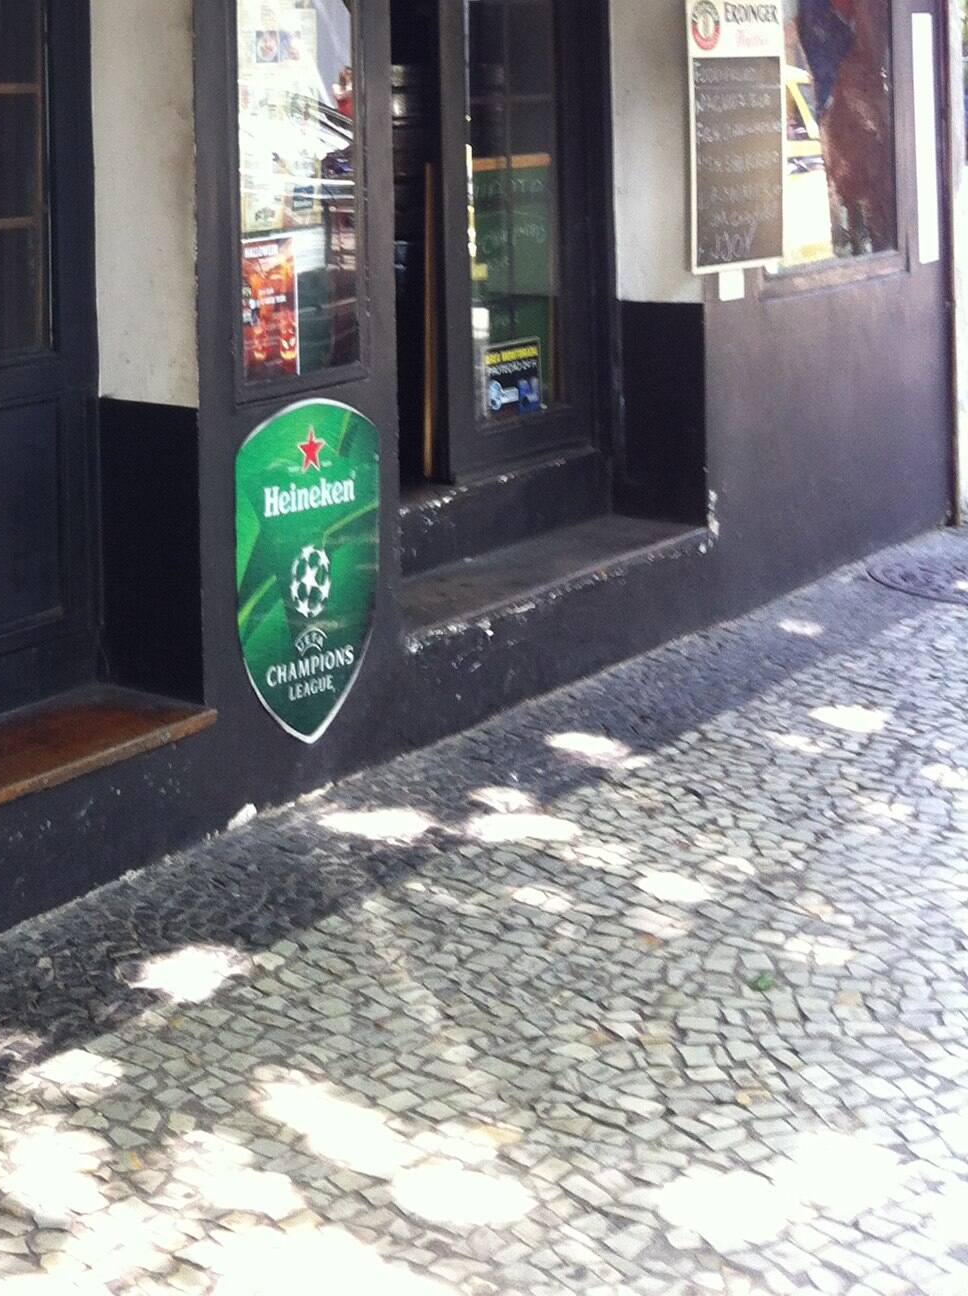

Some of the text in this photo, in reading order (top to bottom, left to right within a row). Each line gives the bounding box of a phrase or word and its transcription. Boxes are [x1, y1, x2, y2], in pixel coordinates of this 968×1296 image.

[723, 2, 779, 25] ERDINGER
[263, 477, 356, 518] Heineken
[295, 630, 325, 654] UEFA
[266, 644, 355, 688] CHAMPIONS
[288, 674, 334, 701] LEAGUE
